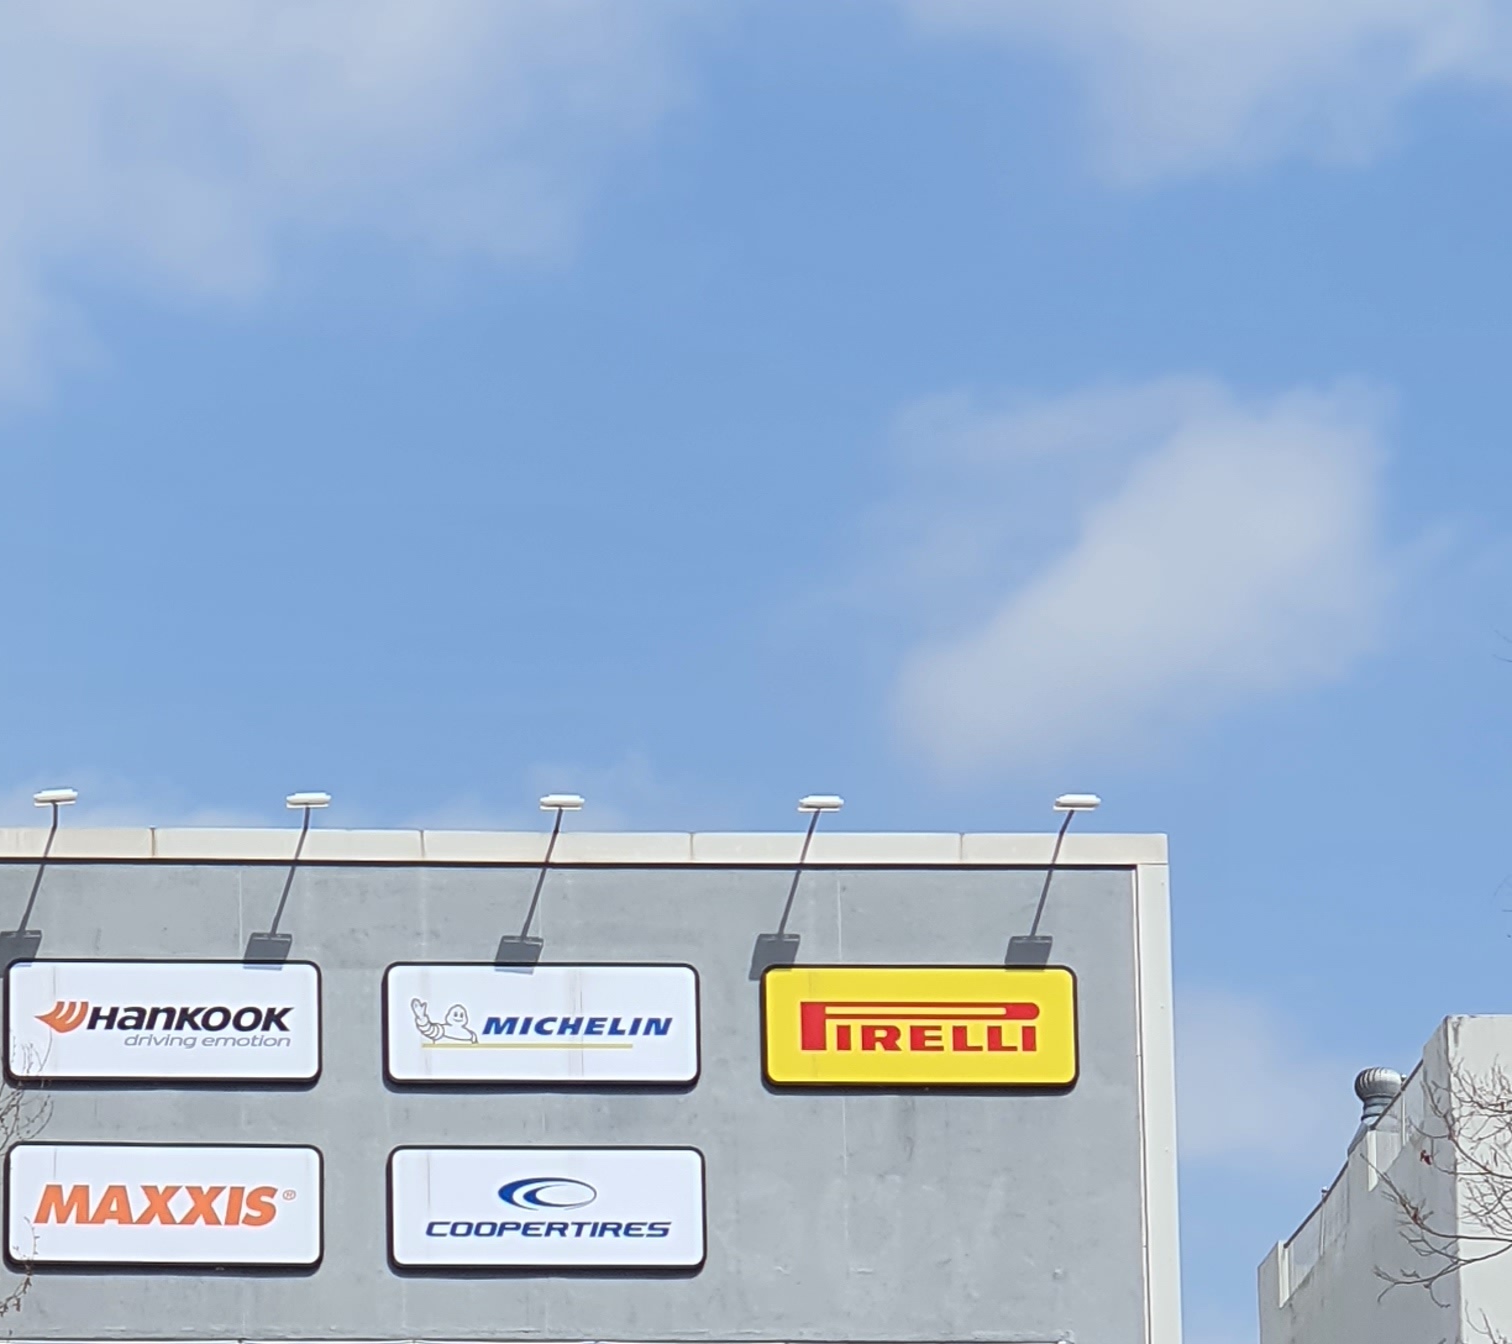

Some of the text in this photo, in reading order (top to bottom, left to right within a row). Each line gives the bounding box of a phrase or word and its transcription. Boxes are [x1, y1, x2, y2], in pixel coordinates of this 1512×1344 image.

[124, 1034, 291, 1049] driving emotion
[482, 1016, 673, 1036] MICHELIN
[800, 1001, 1040, 1052] PIRELLI
[33, 1184, 279, 1226] MAXXIS
